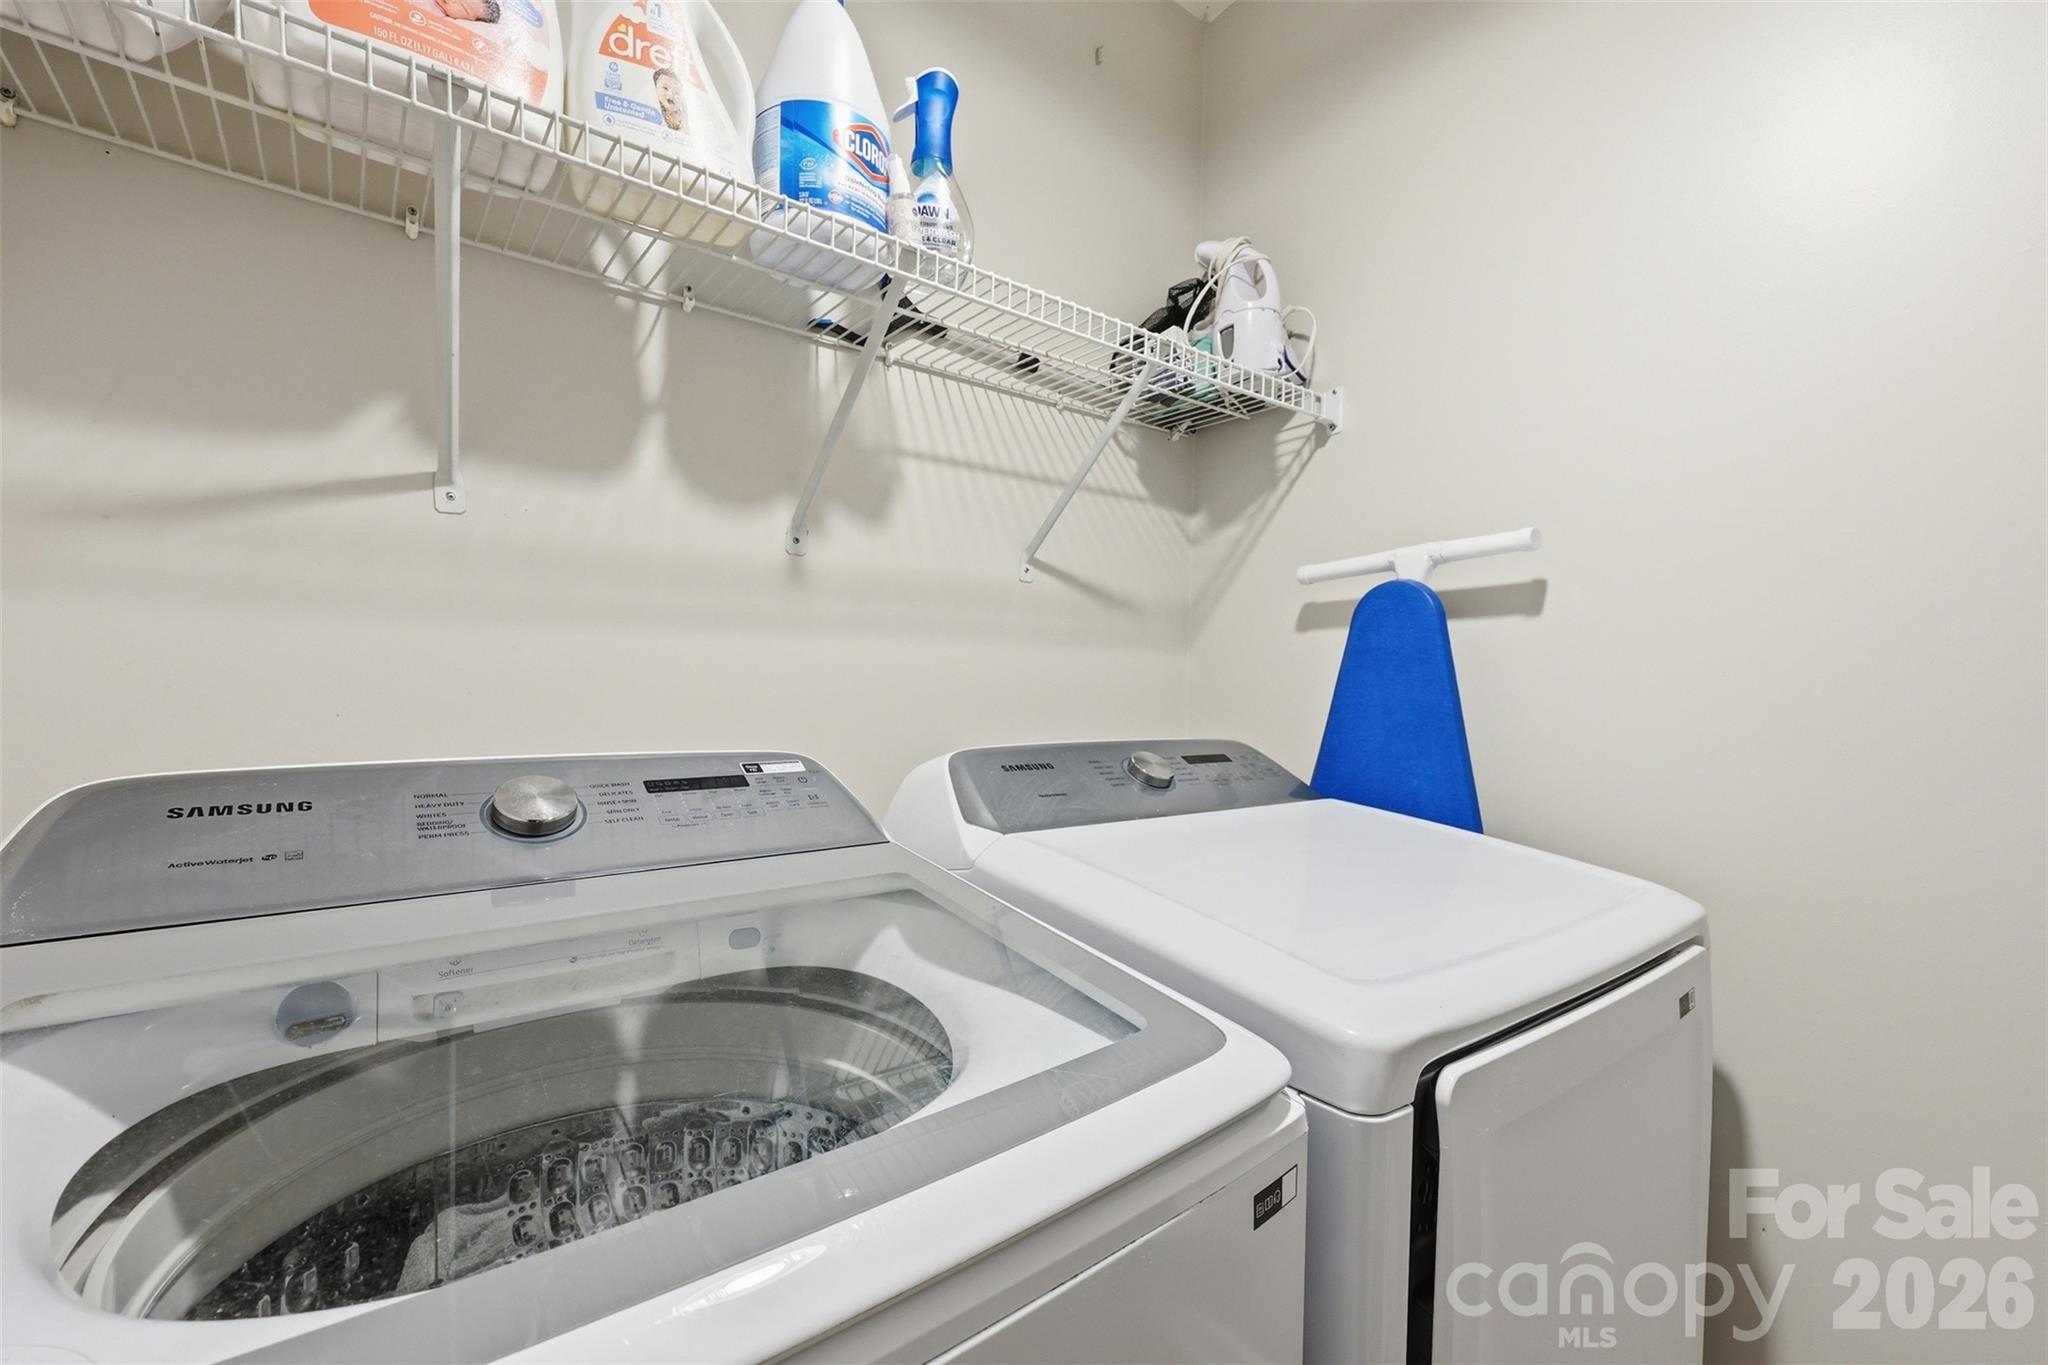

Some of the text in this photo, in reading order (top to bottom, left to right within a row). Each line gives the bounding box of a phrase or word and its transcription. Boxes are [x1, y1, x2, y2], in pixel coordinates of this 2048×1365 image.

[388, 30, 399, 44] FL
[401, 35, 414, 49] OZ
[608, 25, 675, 68] dre
[846, 129, 888, 177] CLORO
[1001, 762, 1055, 772] SAMSUNG
[166, 800, 314, 819] SAMSUNG
[438, 965, 475, 979] Softener
